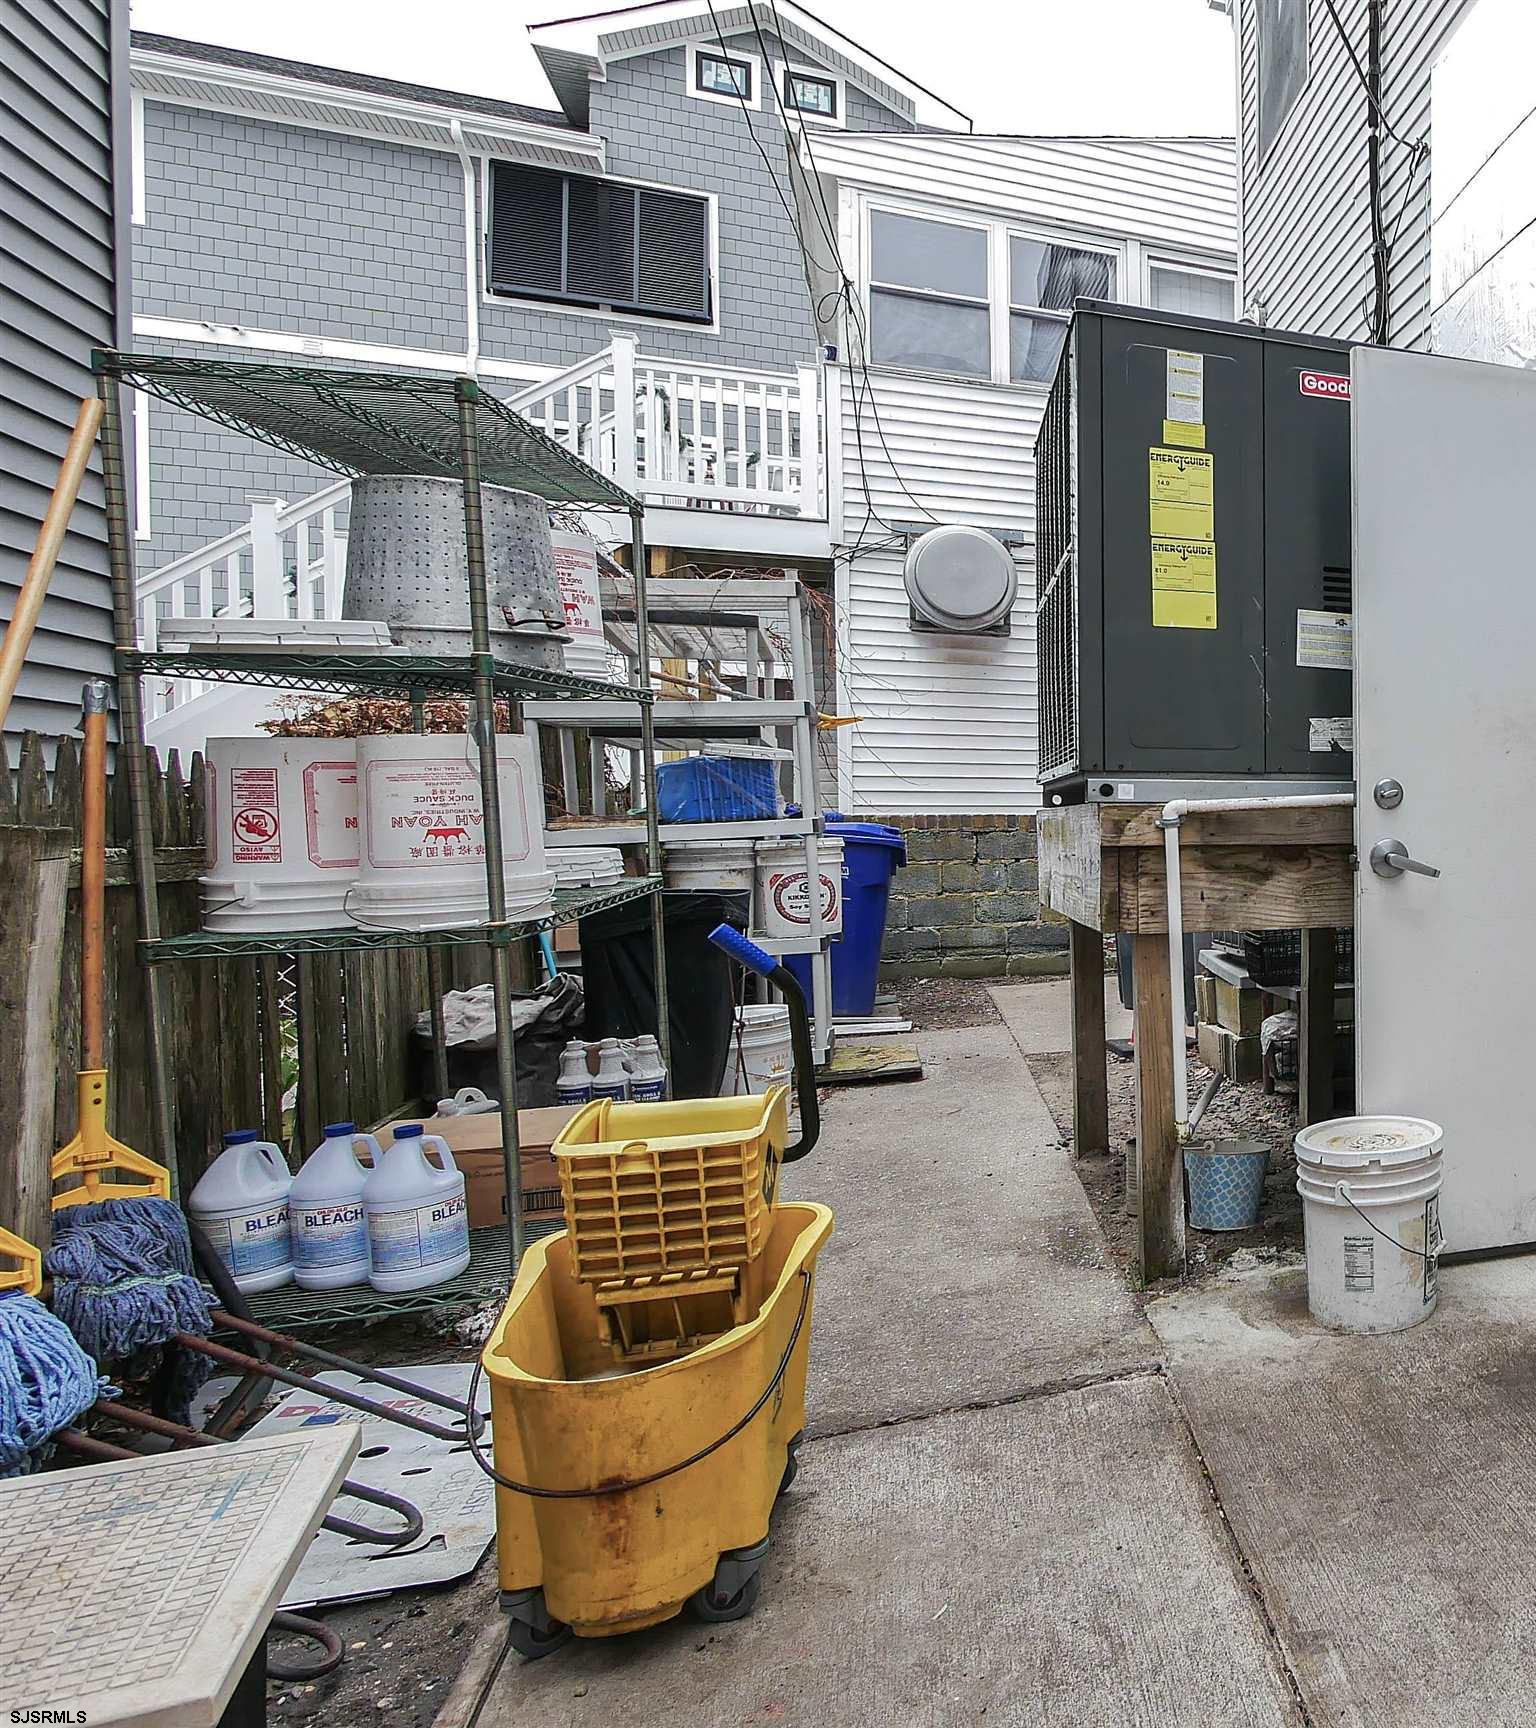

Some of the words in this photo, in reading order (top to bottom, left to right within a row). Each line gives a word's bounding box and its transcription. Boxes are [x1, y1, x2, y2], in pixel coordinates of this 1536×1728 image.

[1303, 375, 1351, 394] Good
[1150, 453, 1211, 469] ENERGYGUIDE
[1152, 543, 1214, 558] ENERGYGUIDE
[448, 794, 474, 802] DUCK
[391, 815, 447, 828] YOAN
[305, 1207, 364, 1227] BLEACH
